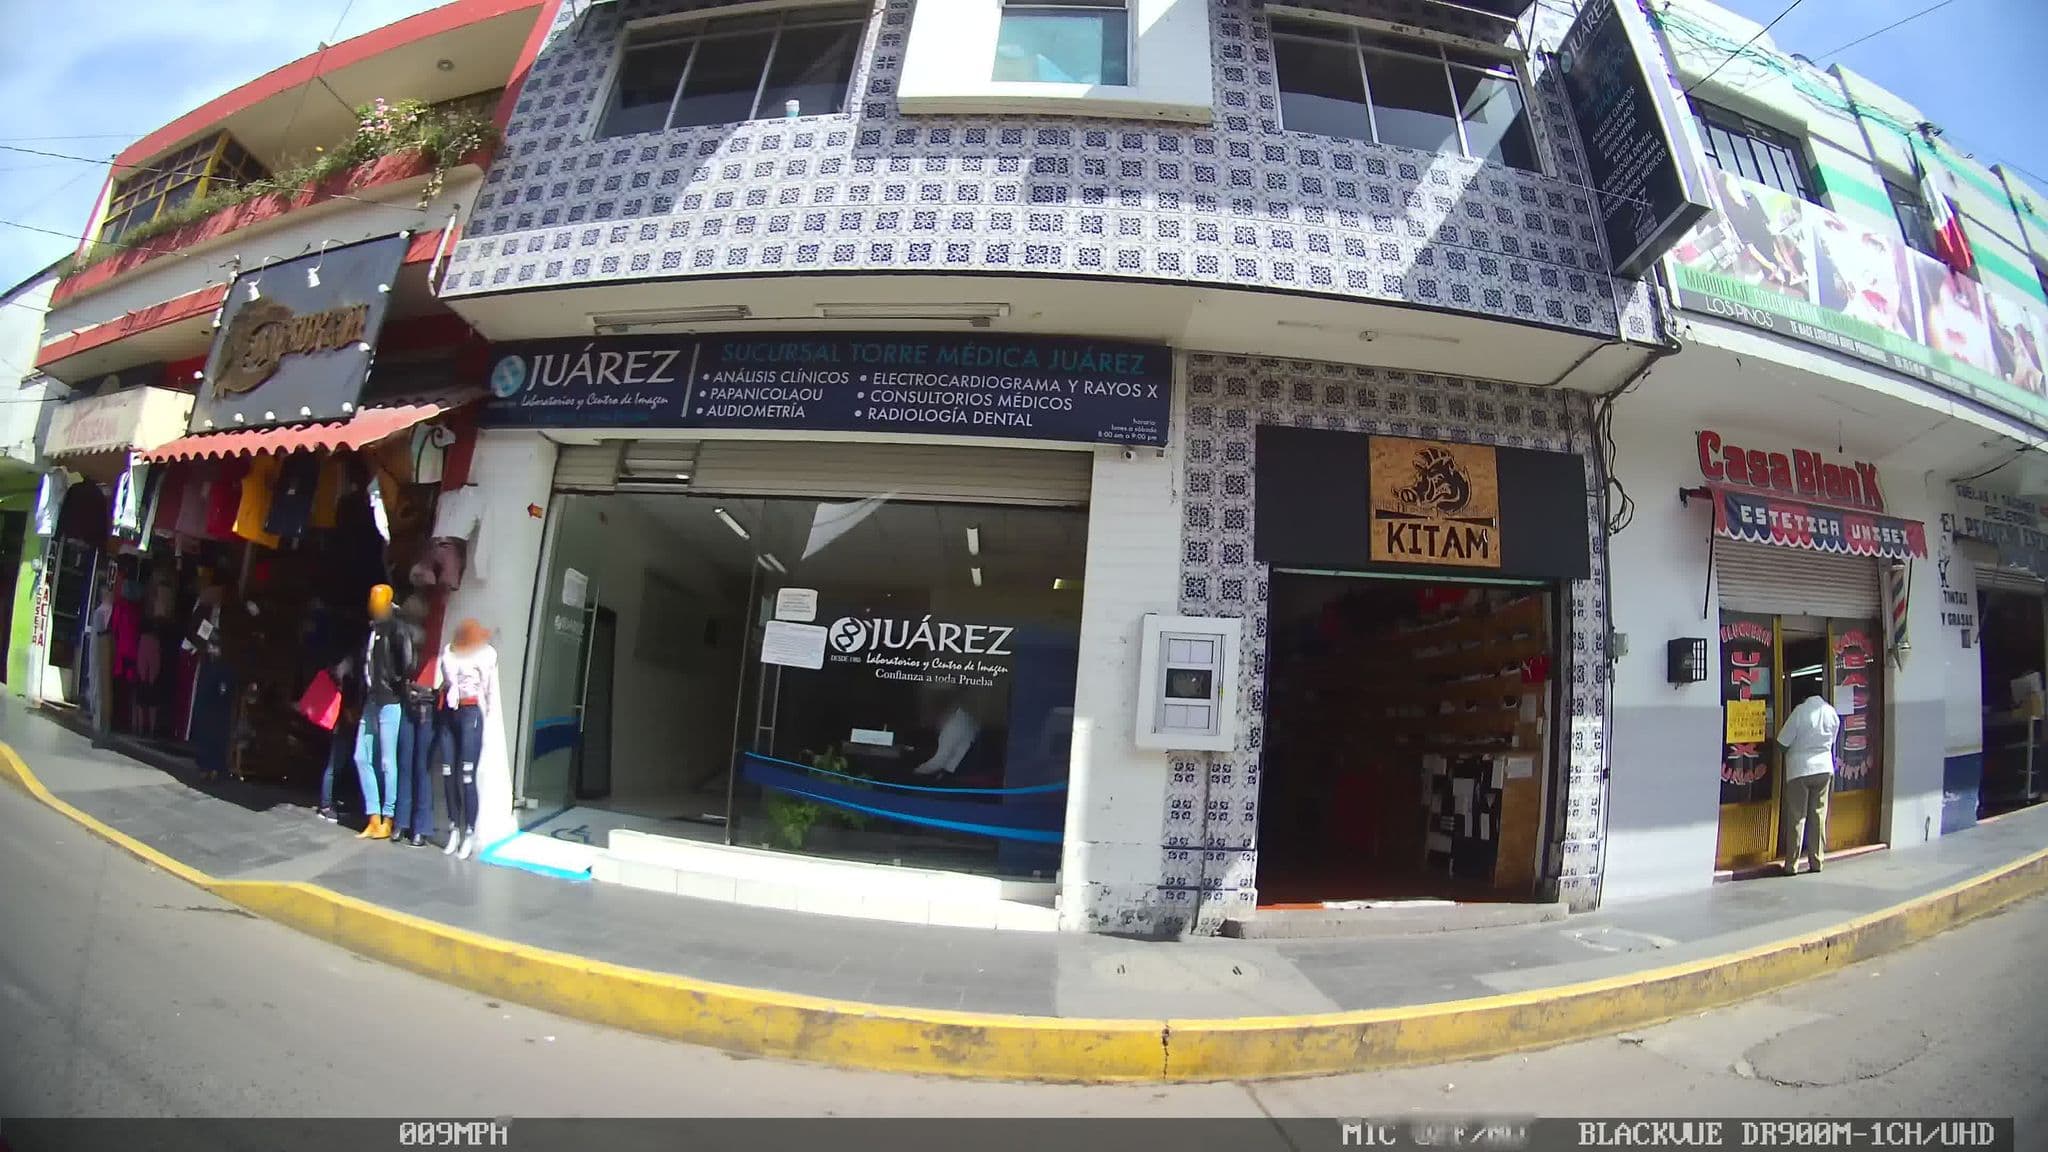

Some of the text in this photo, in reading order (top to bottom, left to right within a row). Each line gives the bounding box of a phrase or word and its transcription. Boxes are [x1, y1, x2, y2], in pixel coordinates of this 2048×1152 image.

[1705, 296, 1774, 329] LOS PINOS
[527, 343, 680, 391] JUÁREZ
[721, 342, 1146, 376] SUCURSAL TORRE MÉDICA JUÁREZ
[713, 367, 849, 385] ANÁLISIS CLÍNICOS
[873, 372, 1158, 399] ELECTROCARDIOGRAMA Y RAYOS X
[521, 394, 575, 408] Laboratorios
[576, 398, 584, 410] y
[587, 393, 618, 406] Centro
[620, 393, 632, 405] de
[634, 393, 668, 410] Imagen
[710, 388, 823, 401] PAPANICOLAOU
[870, 390, 1073, 411] CONSULTORIOS MÉDICOS
[706, 403, 806, 418] AUDIOMETRÍA
[867, 406, 1033, 427] RADIOLOGÍA DENTAL
[1740, 504, 1909, 545] ESTETICA UNISEX
[1387, 521, 1489, 559] KITAM
[868, 614, 1014, 656] JUÁREZ
[867, 653, 1008, 677] Laboratorios y Centro de Imagen
[875, 668, 924, 682] Confianza
[935, 674, 956, 685] toda
[959, 674, 993, 687] Prueba
